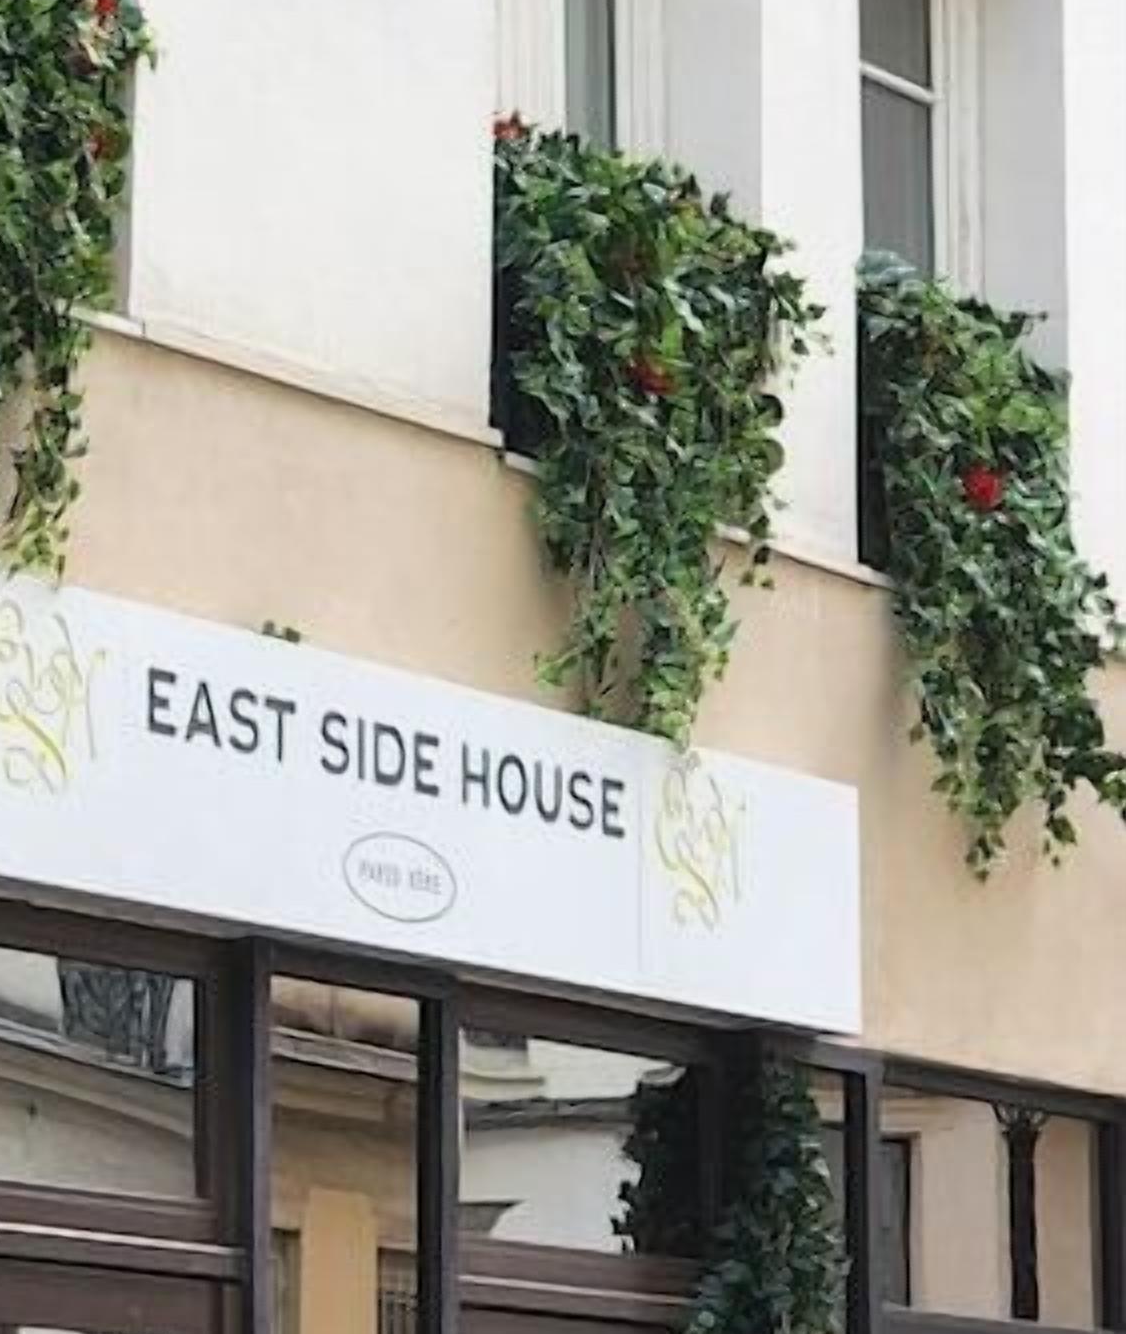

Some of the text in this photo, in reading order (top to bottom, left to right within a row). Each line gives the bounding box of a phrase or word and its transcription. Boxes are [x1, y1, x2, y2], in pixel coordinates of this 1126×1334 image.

[146, 666, 626, 839] EAST SIDE HOUSE
